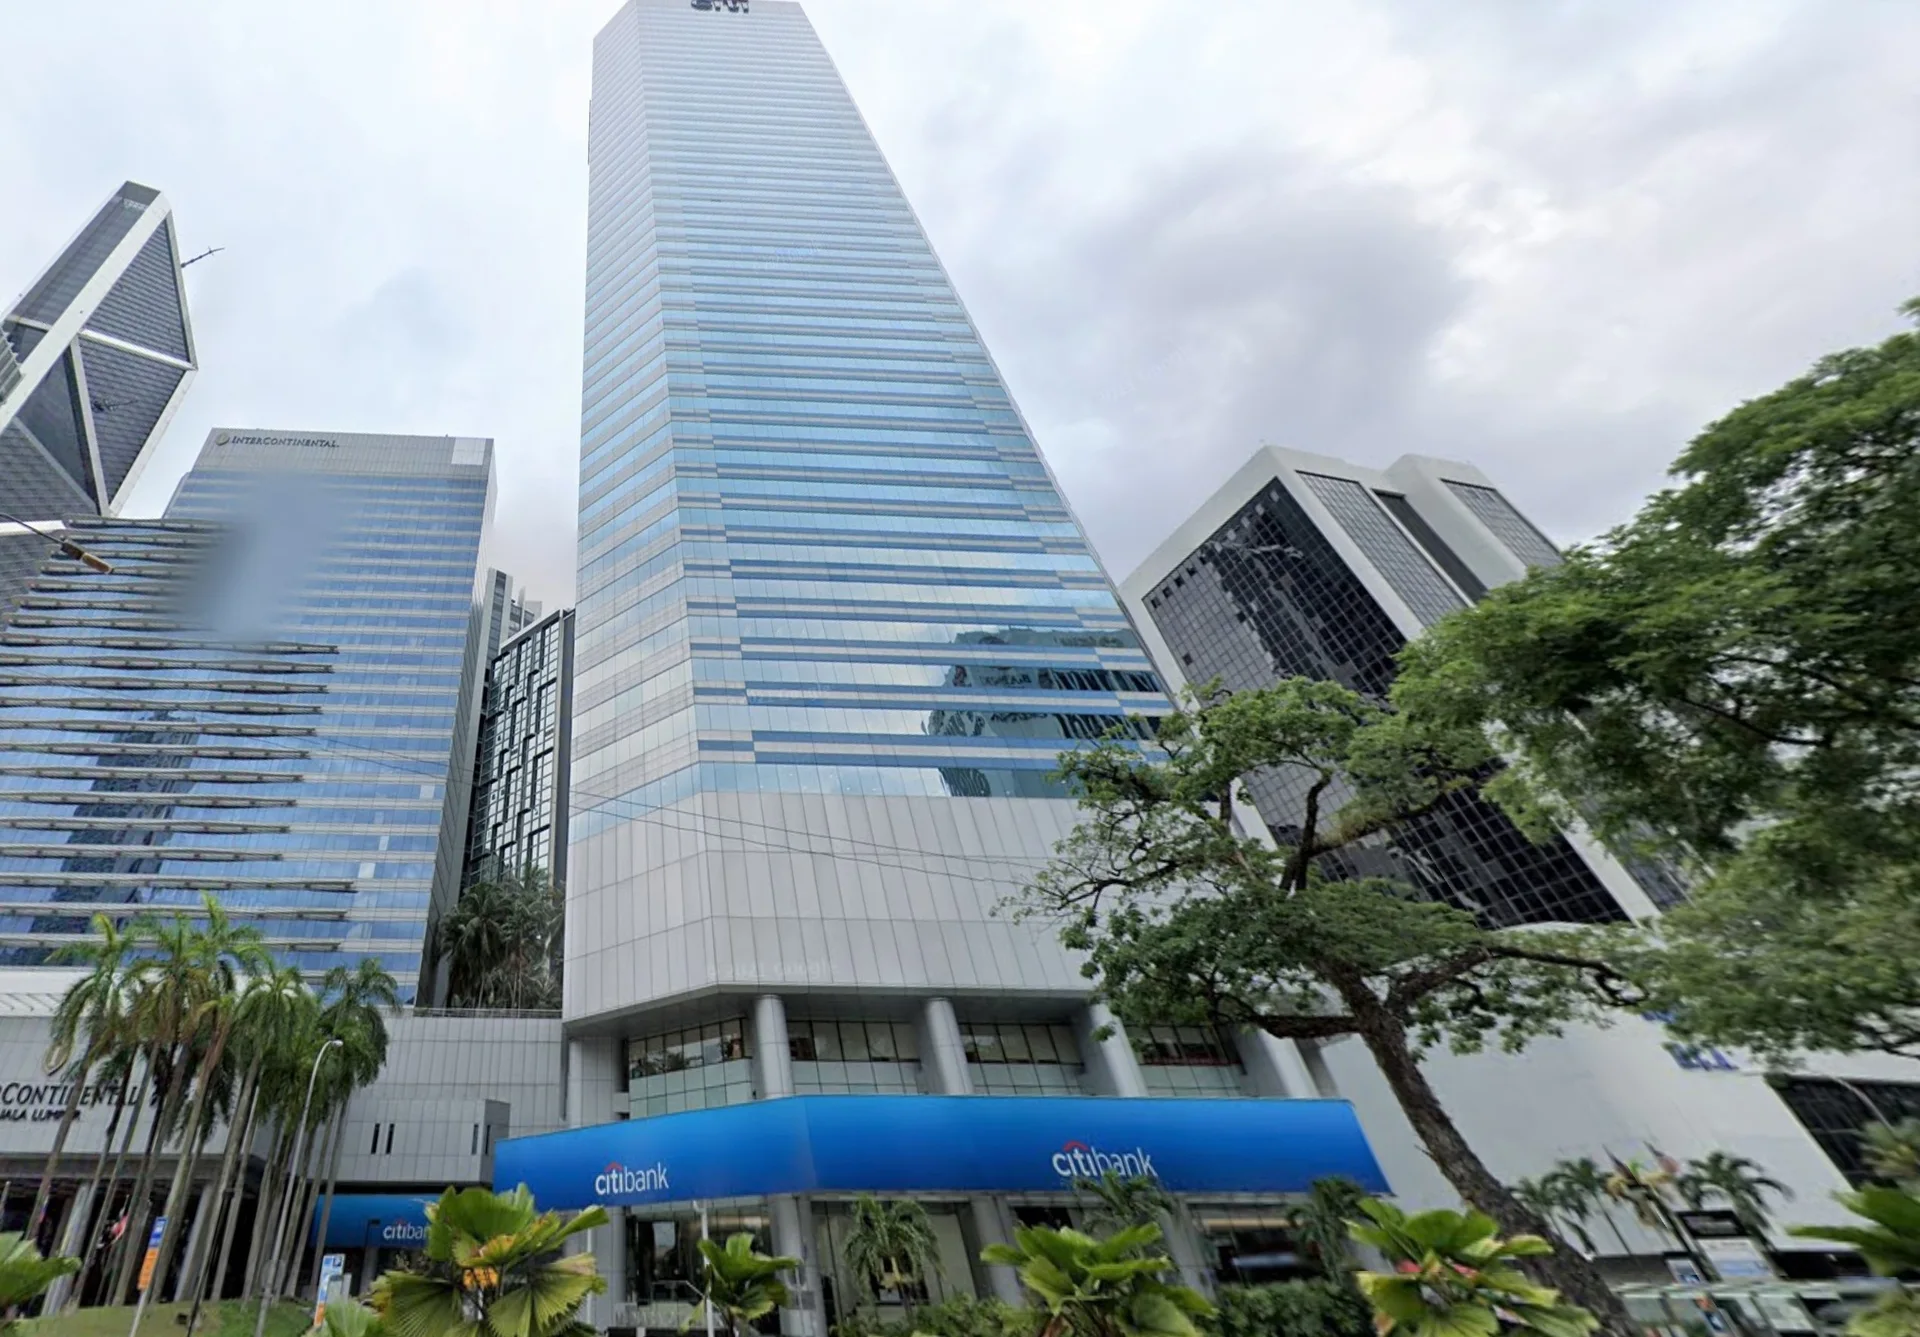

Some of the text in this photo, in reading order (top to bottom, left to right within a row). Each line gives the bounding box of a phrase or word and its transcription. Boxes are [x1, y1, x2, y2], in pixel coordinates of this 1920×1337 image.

[0, 1082, 138, 1106] CONTIENTL
[31, 1108, 81, 1122] LUMPR
[1051, 1141, 1159, 1178] citibank
[595, 1161, 670, 1196] citibank
[382, 1220, 432, 1241] citiban
